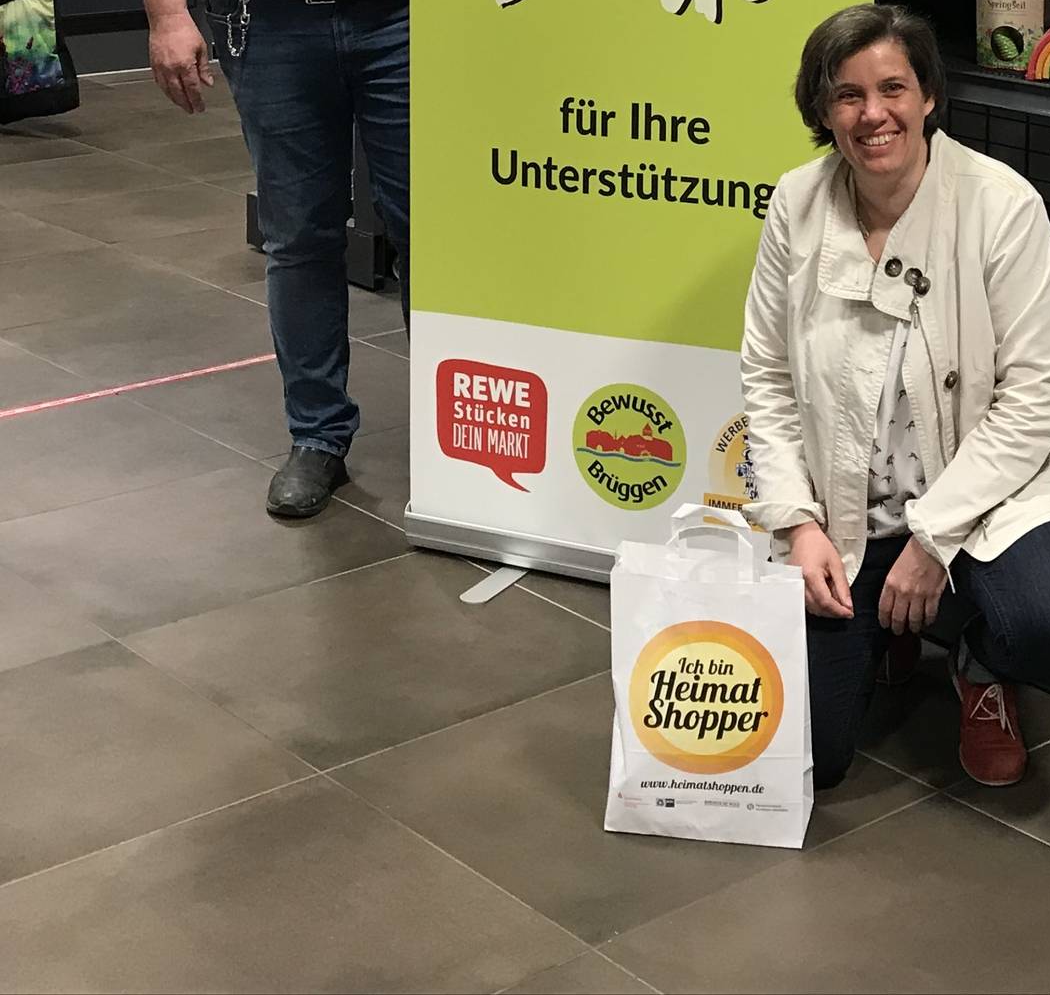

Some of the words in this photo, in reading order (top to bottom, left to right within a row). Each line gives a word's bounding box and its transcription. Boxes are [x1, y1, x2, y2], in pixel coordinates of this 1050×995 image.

[559, 97, 616, 138] für
[630, 102, 711, 145] Ihre
[490, 148, 776, 220] Unterstützung
[453, 372, 531, 408] REWE
[453, 401, 531, 430] Stücken
[586, 393, 673, 434] Bewusst
[453, 422, 483, 452] DEIN
[487, 426, 530, 459] MARKT
[587, 459, 668, 503] Brüggen
[678, 656, 705, 676] Ich
[709, 659, 734, 676] bin
[650, 670, 762, 705] Heimat
[643, 698, 769, 741] Shopper
[640, 779, 765, 794] www.heimatshoppen.de
